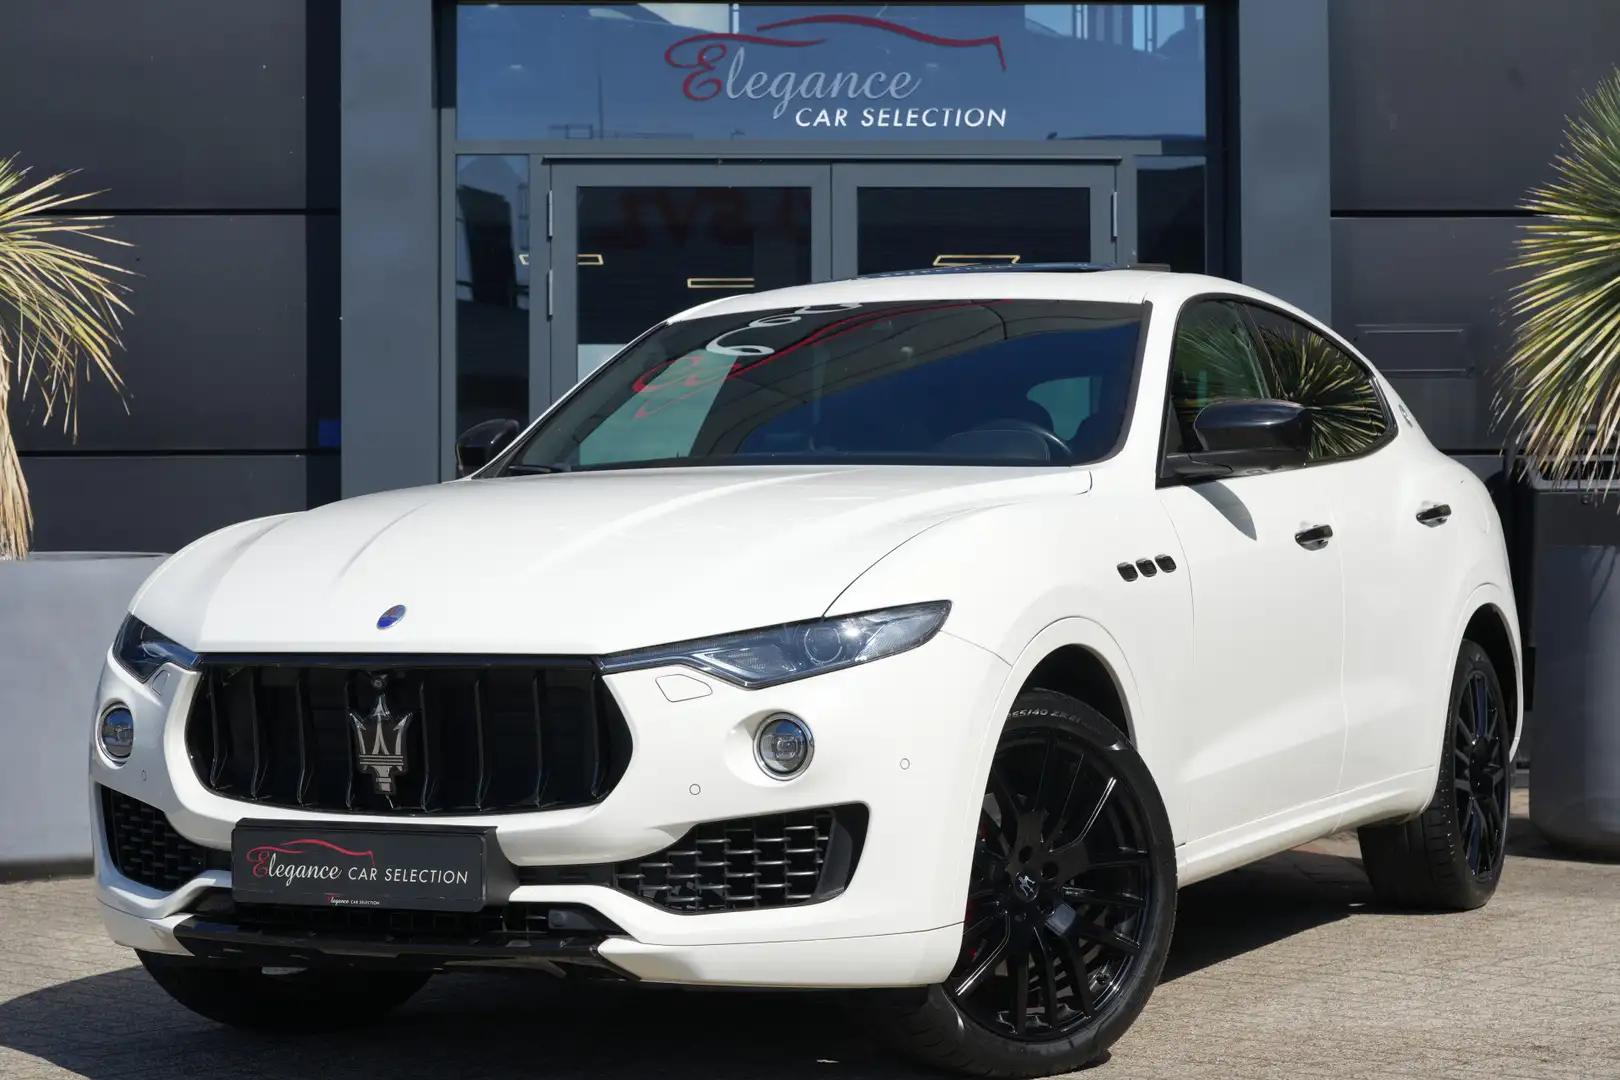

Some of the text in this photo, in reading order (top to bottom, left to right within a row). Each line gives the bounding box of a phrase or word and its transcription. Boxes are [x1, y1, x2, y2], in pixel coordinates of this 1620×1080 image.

[664, 33, 921, 119] Elegance
[795, 108, 1007, 127] CAR SELECTION
[247, 847, 468, 886] Elegance CAR SELECTION
